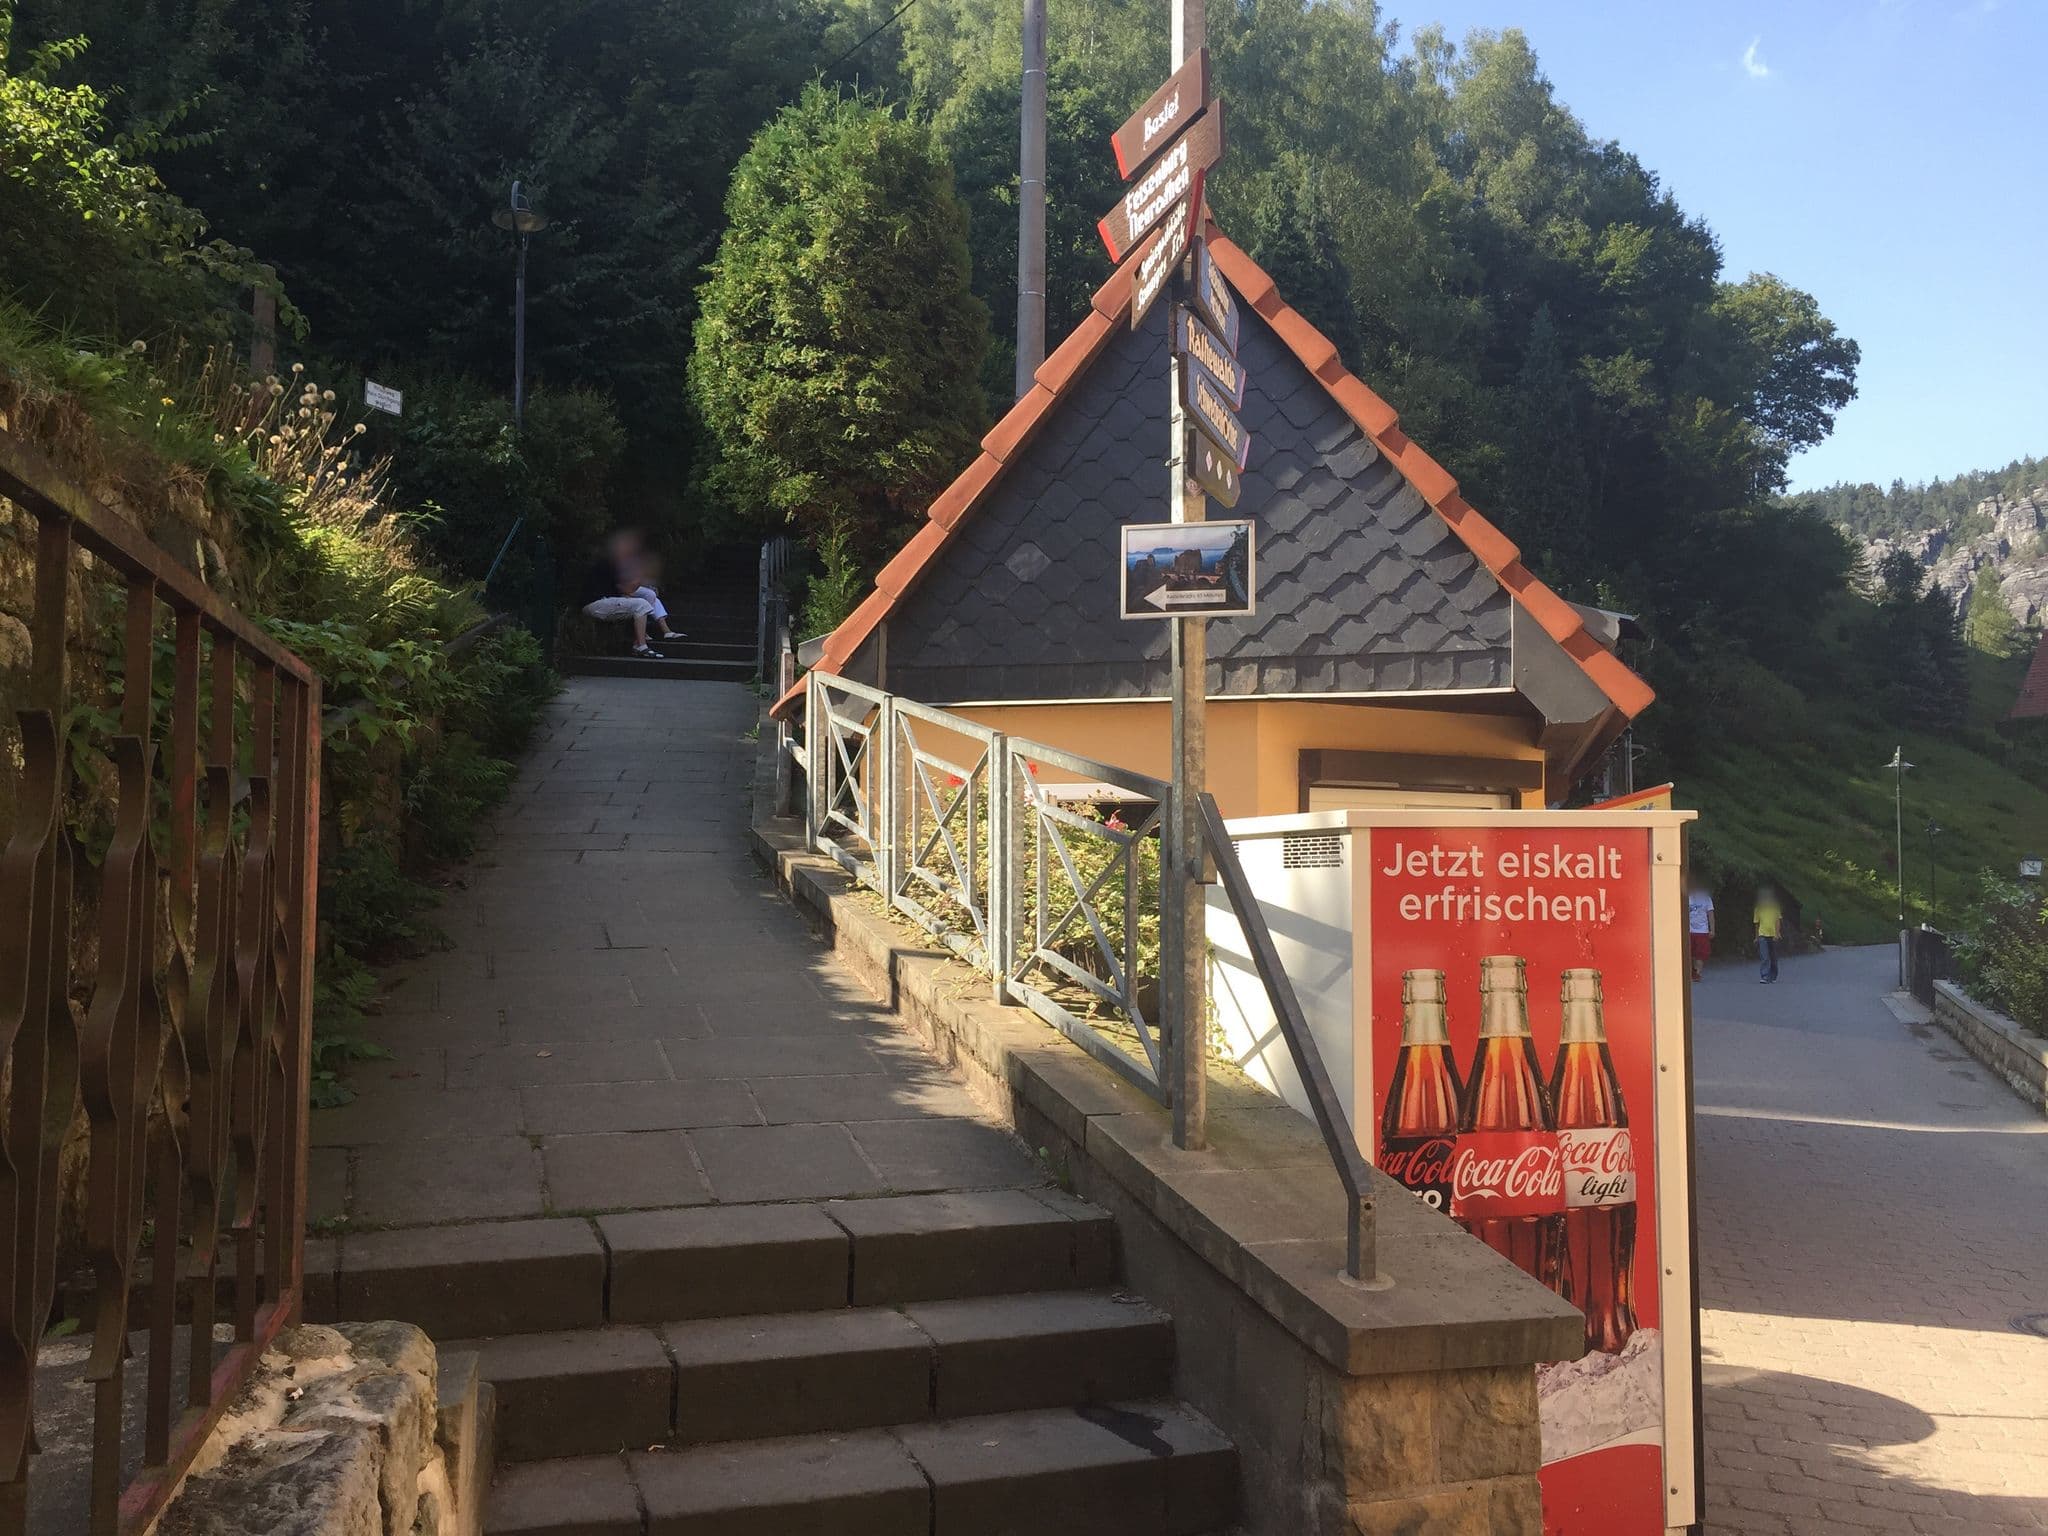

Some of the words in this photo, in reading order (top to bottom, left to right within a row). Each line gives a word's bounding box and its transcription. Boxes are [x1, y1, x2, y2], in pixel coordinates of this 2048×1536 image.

[1143, 85, 1180, 143] Bastei
[1125, 138, 1188, 217] Felsenburg
[1129, 165, 1190, 241] Neurathen
[1187, 315, 1236, 394] Rathewalde
[1383, 843, 1484, 877] Jetzt
[1498, 843, 1622, 879] eiskalt
[1400, 886, 1607, 922] erfrischen!
[1453, 1146, 1562, 1200] Coca-Cola
[1578, 1175, 1627, 1203] light
